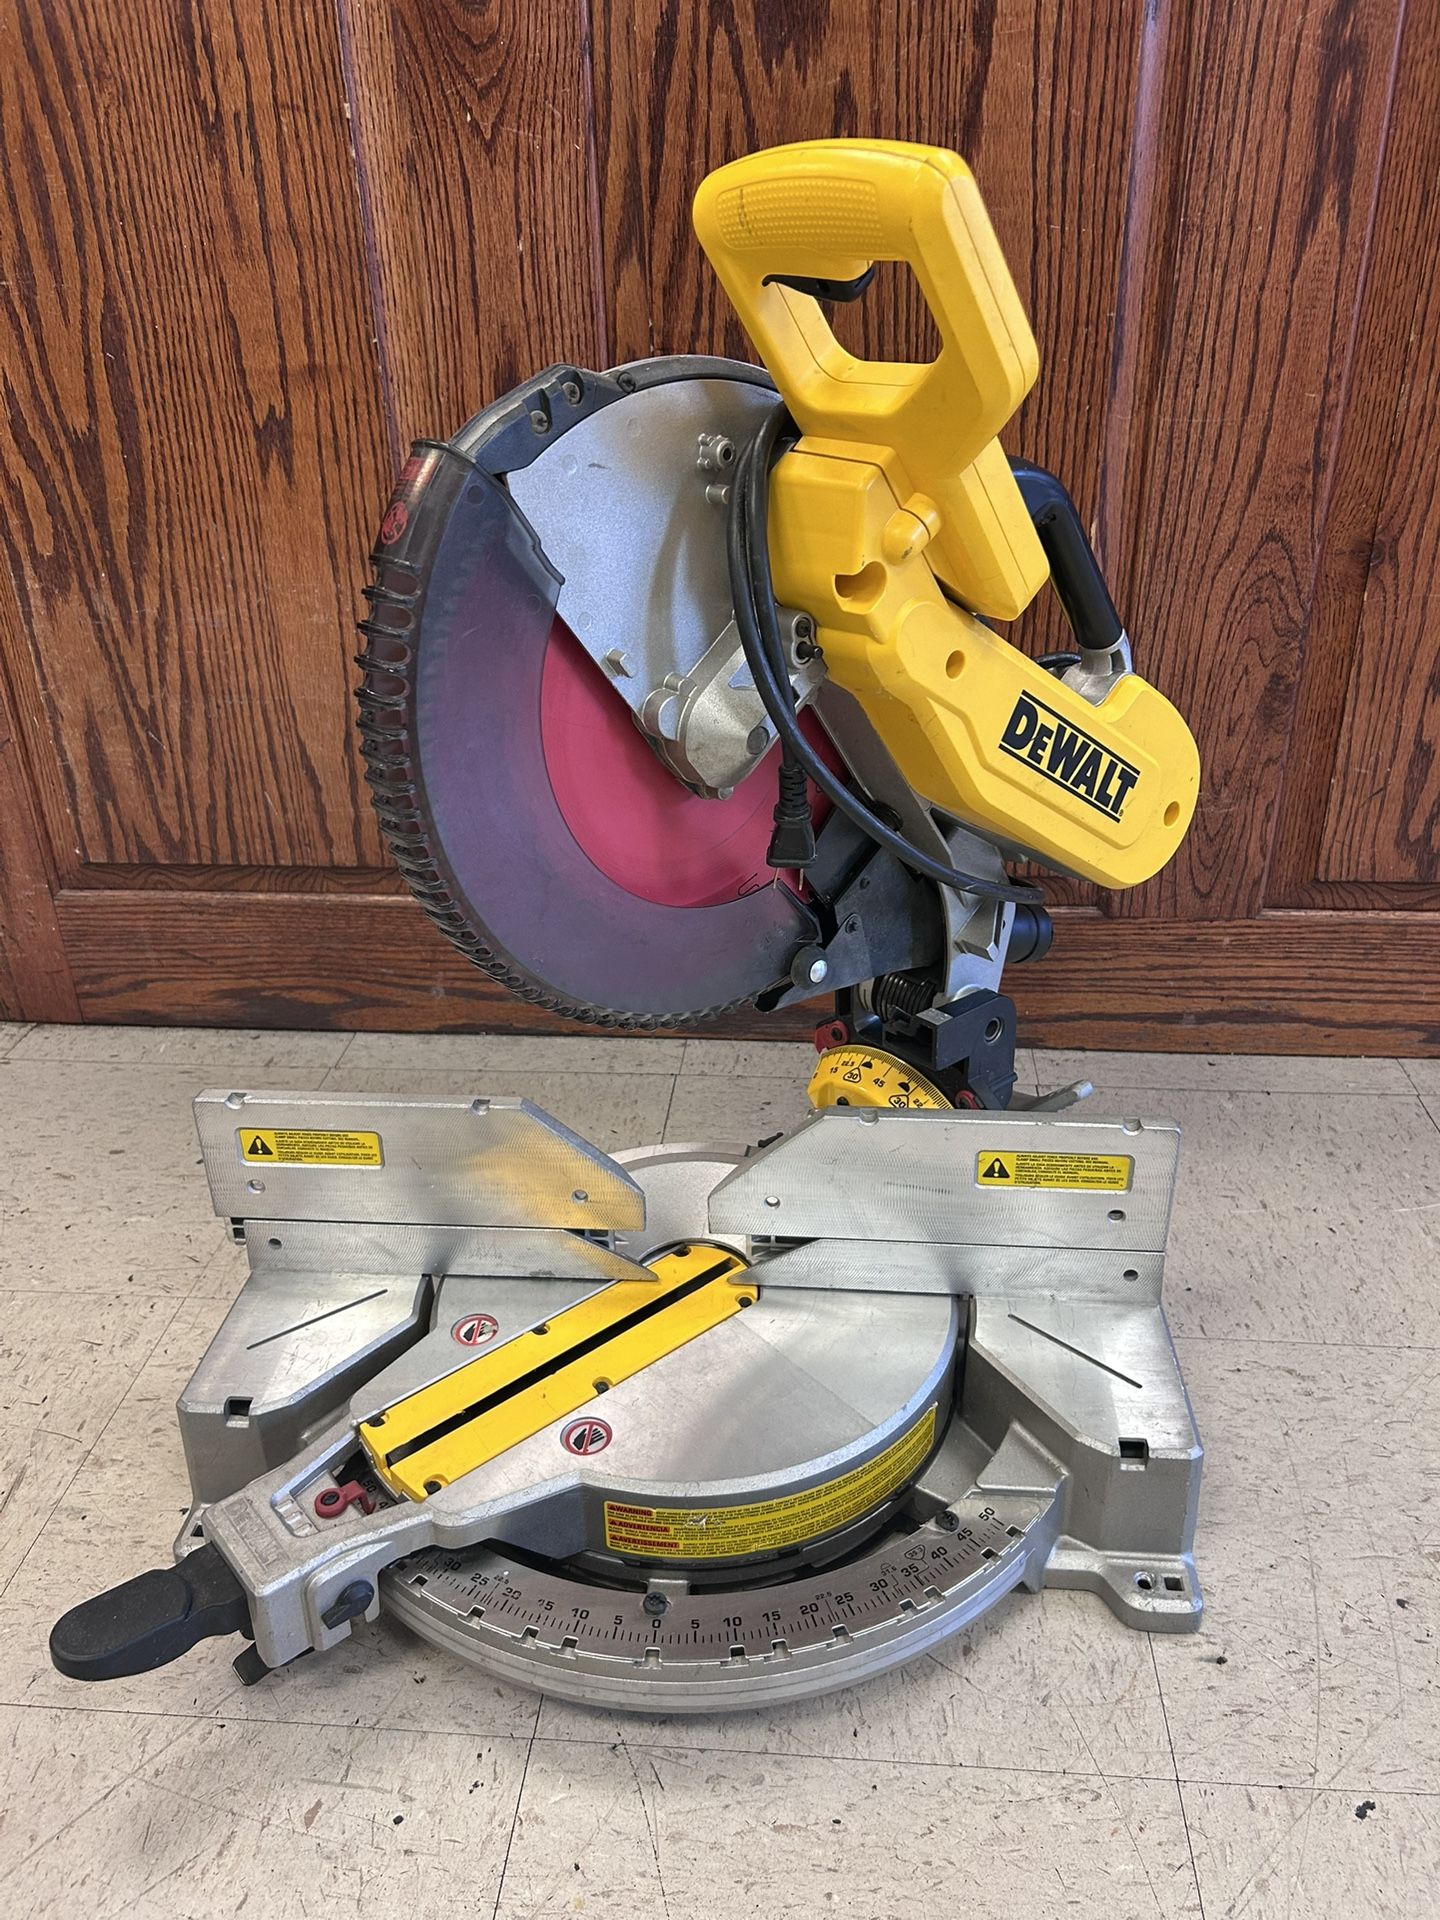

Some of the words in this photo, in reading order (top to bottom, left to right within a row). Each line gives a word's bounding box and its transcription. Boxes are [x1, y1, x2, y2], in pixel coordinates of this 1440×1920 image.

[873, 1078, 886, 1088] 45
[893, 1097, 906, 1108] 30
[363, 1480, 376, 1493] 50
[444, 1557, 461, 1571] 30
[470, 1572, 490, 1586] 25
[502, 1587, 521, 1600] 20
[537, 1598, 555, 1611] 15
[571, 1607, 589, 1620] 10
[614, 1615, 623, 1625] 5
[652, 1618, 661, 1628] 0
[691, 1619, 700, 1629] 5
[723, 1616, 742, 1627] 10
[762, 1610, 781, 1622] 15
[800, 1602, 820, 1615] 20
[834, 1592, 854, 1605] 25
[869, 1578, 888, 1591] 30
[901, 1563, 919, 1577] 35
[931, 1546, 948, 1559] 40
[956, 1528, 973, 1541] 45
[978, 1507, 995, 1521] 50
[815, 1591, 832, 1601] 22.5
